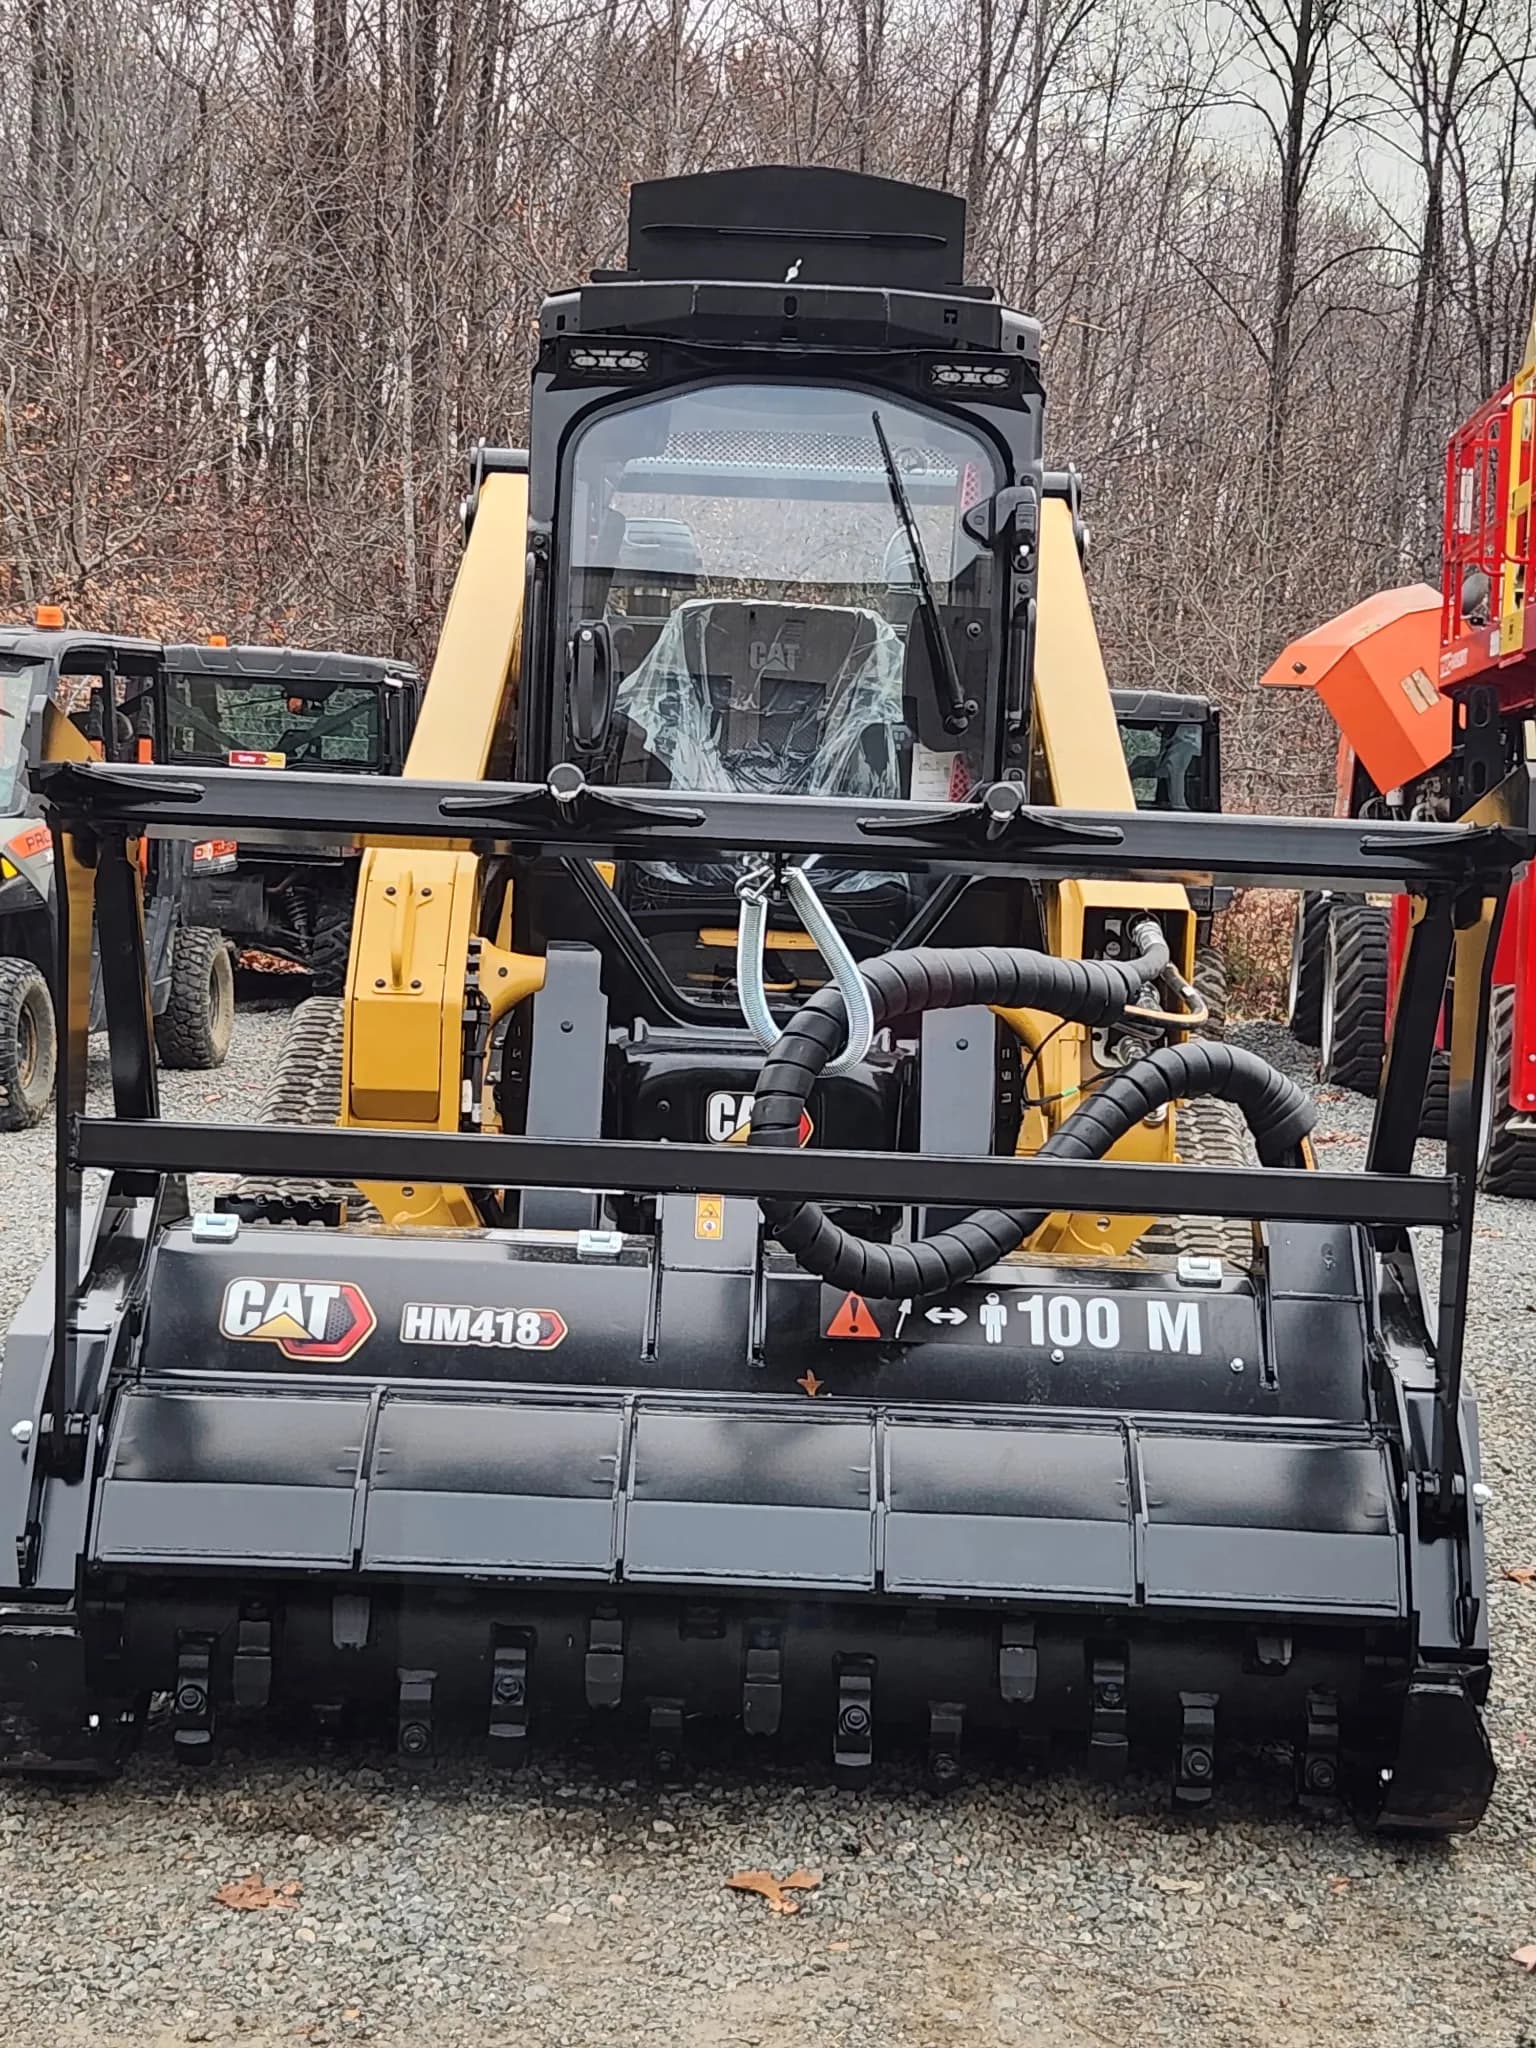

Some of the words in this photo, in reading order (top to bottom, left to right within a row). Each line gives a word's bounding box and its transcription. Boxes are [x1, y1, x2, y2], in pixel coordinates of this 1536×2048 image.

[750, 641, 800, 672] CAT
[709, 1093, 756, 1142] CA
[223, 1279, 340, 1341] CAT
[404, 1305, 541, 1345] HM418
[1017, 1294, 1120, 1349] 100
[1147, 1300, 1202, 1356] M
